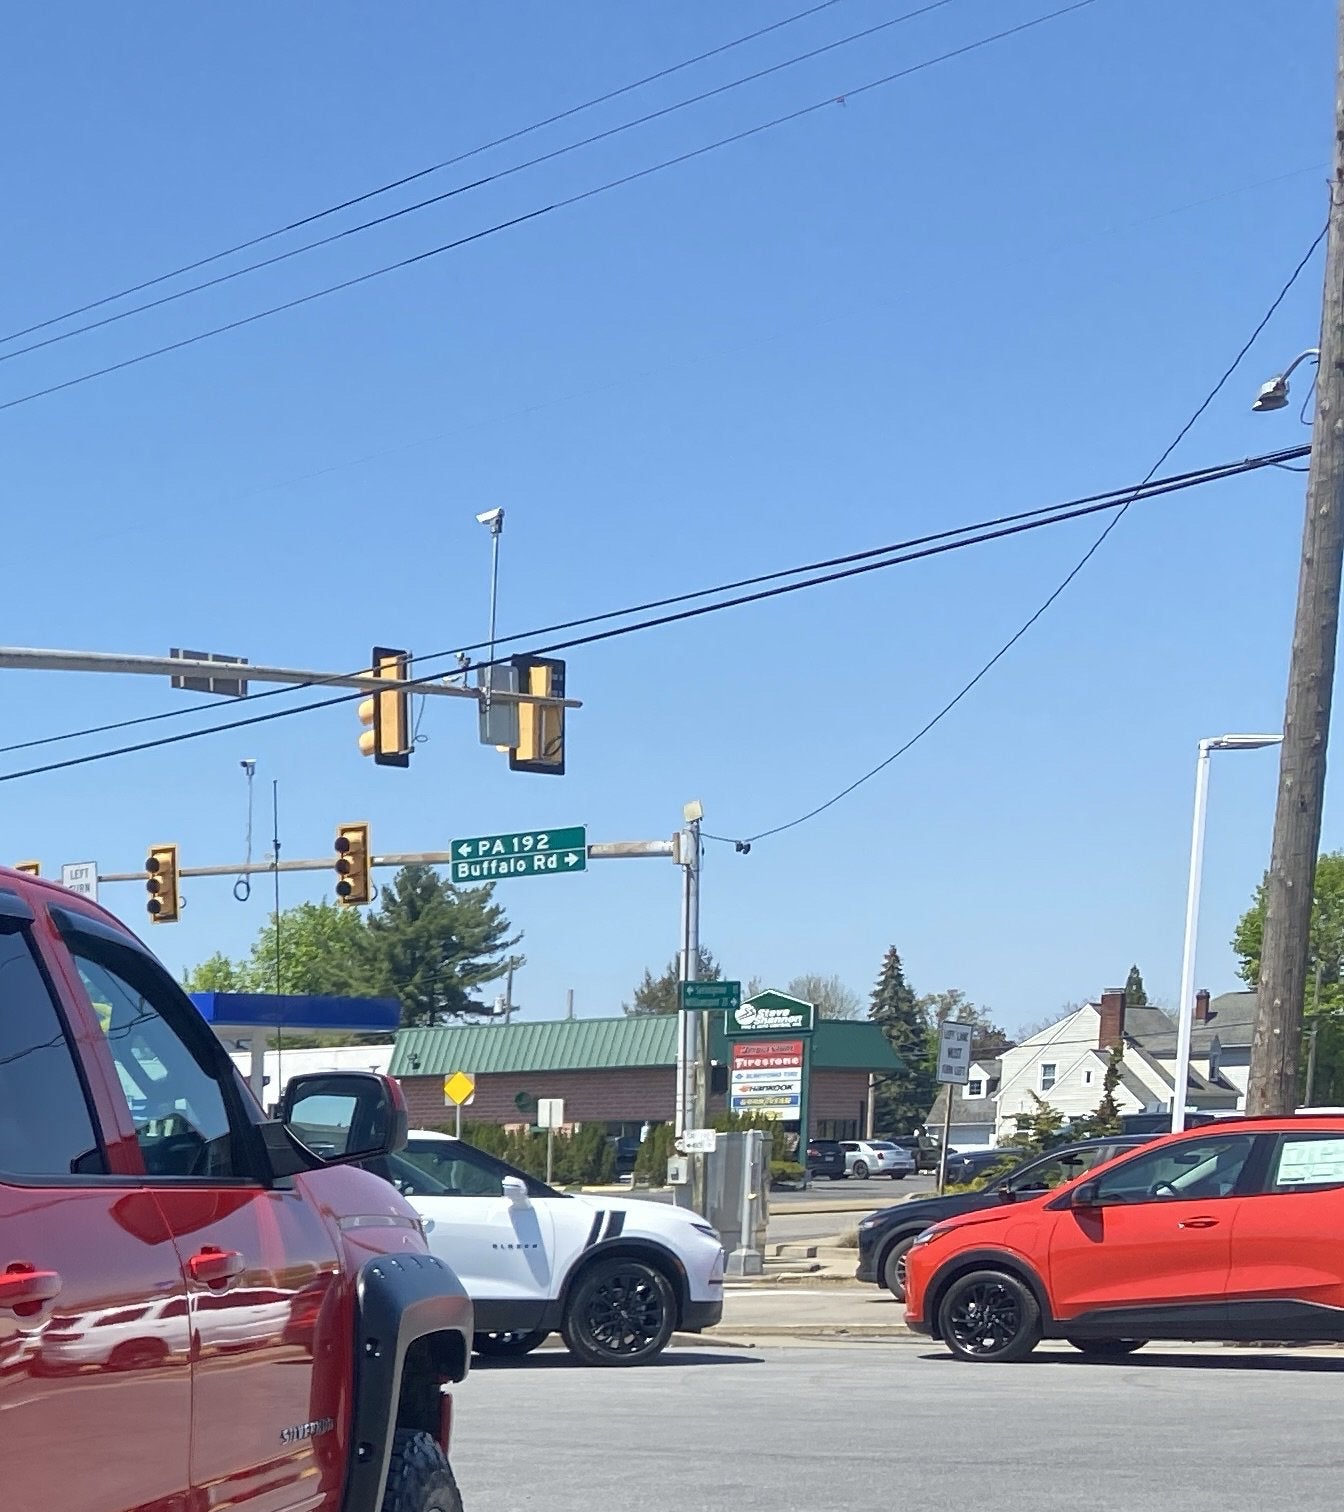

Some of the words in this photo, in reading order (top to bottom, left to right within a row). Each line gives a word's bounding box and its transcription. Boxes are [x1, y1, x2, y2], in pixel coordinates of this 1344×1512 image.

[478, 839, 505, 856] PA
[512, 834, 550, 852] 192
[70, 868, 89, 880] LEFT
[457, 858, 527, 878] Buffalo
[533, 854, 558, 871] Rd
